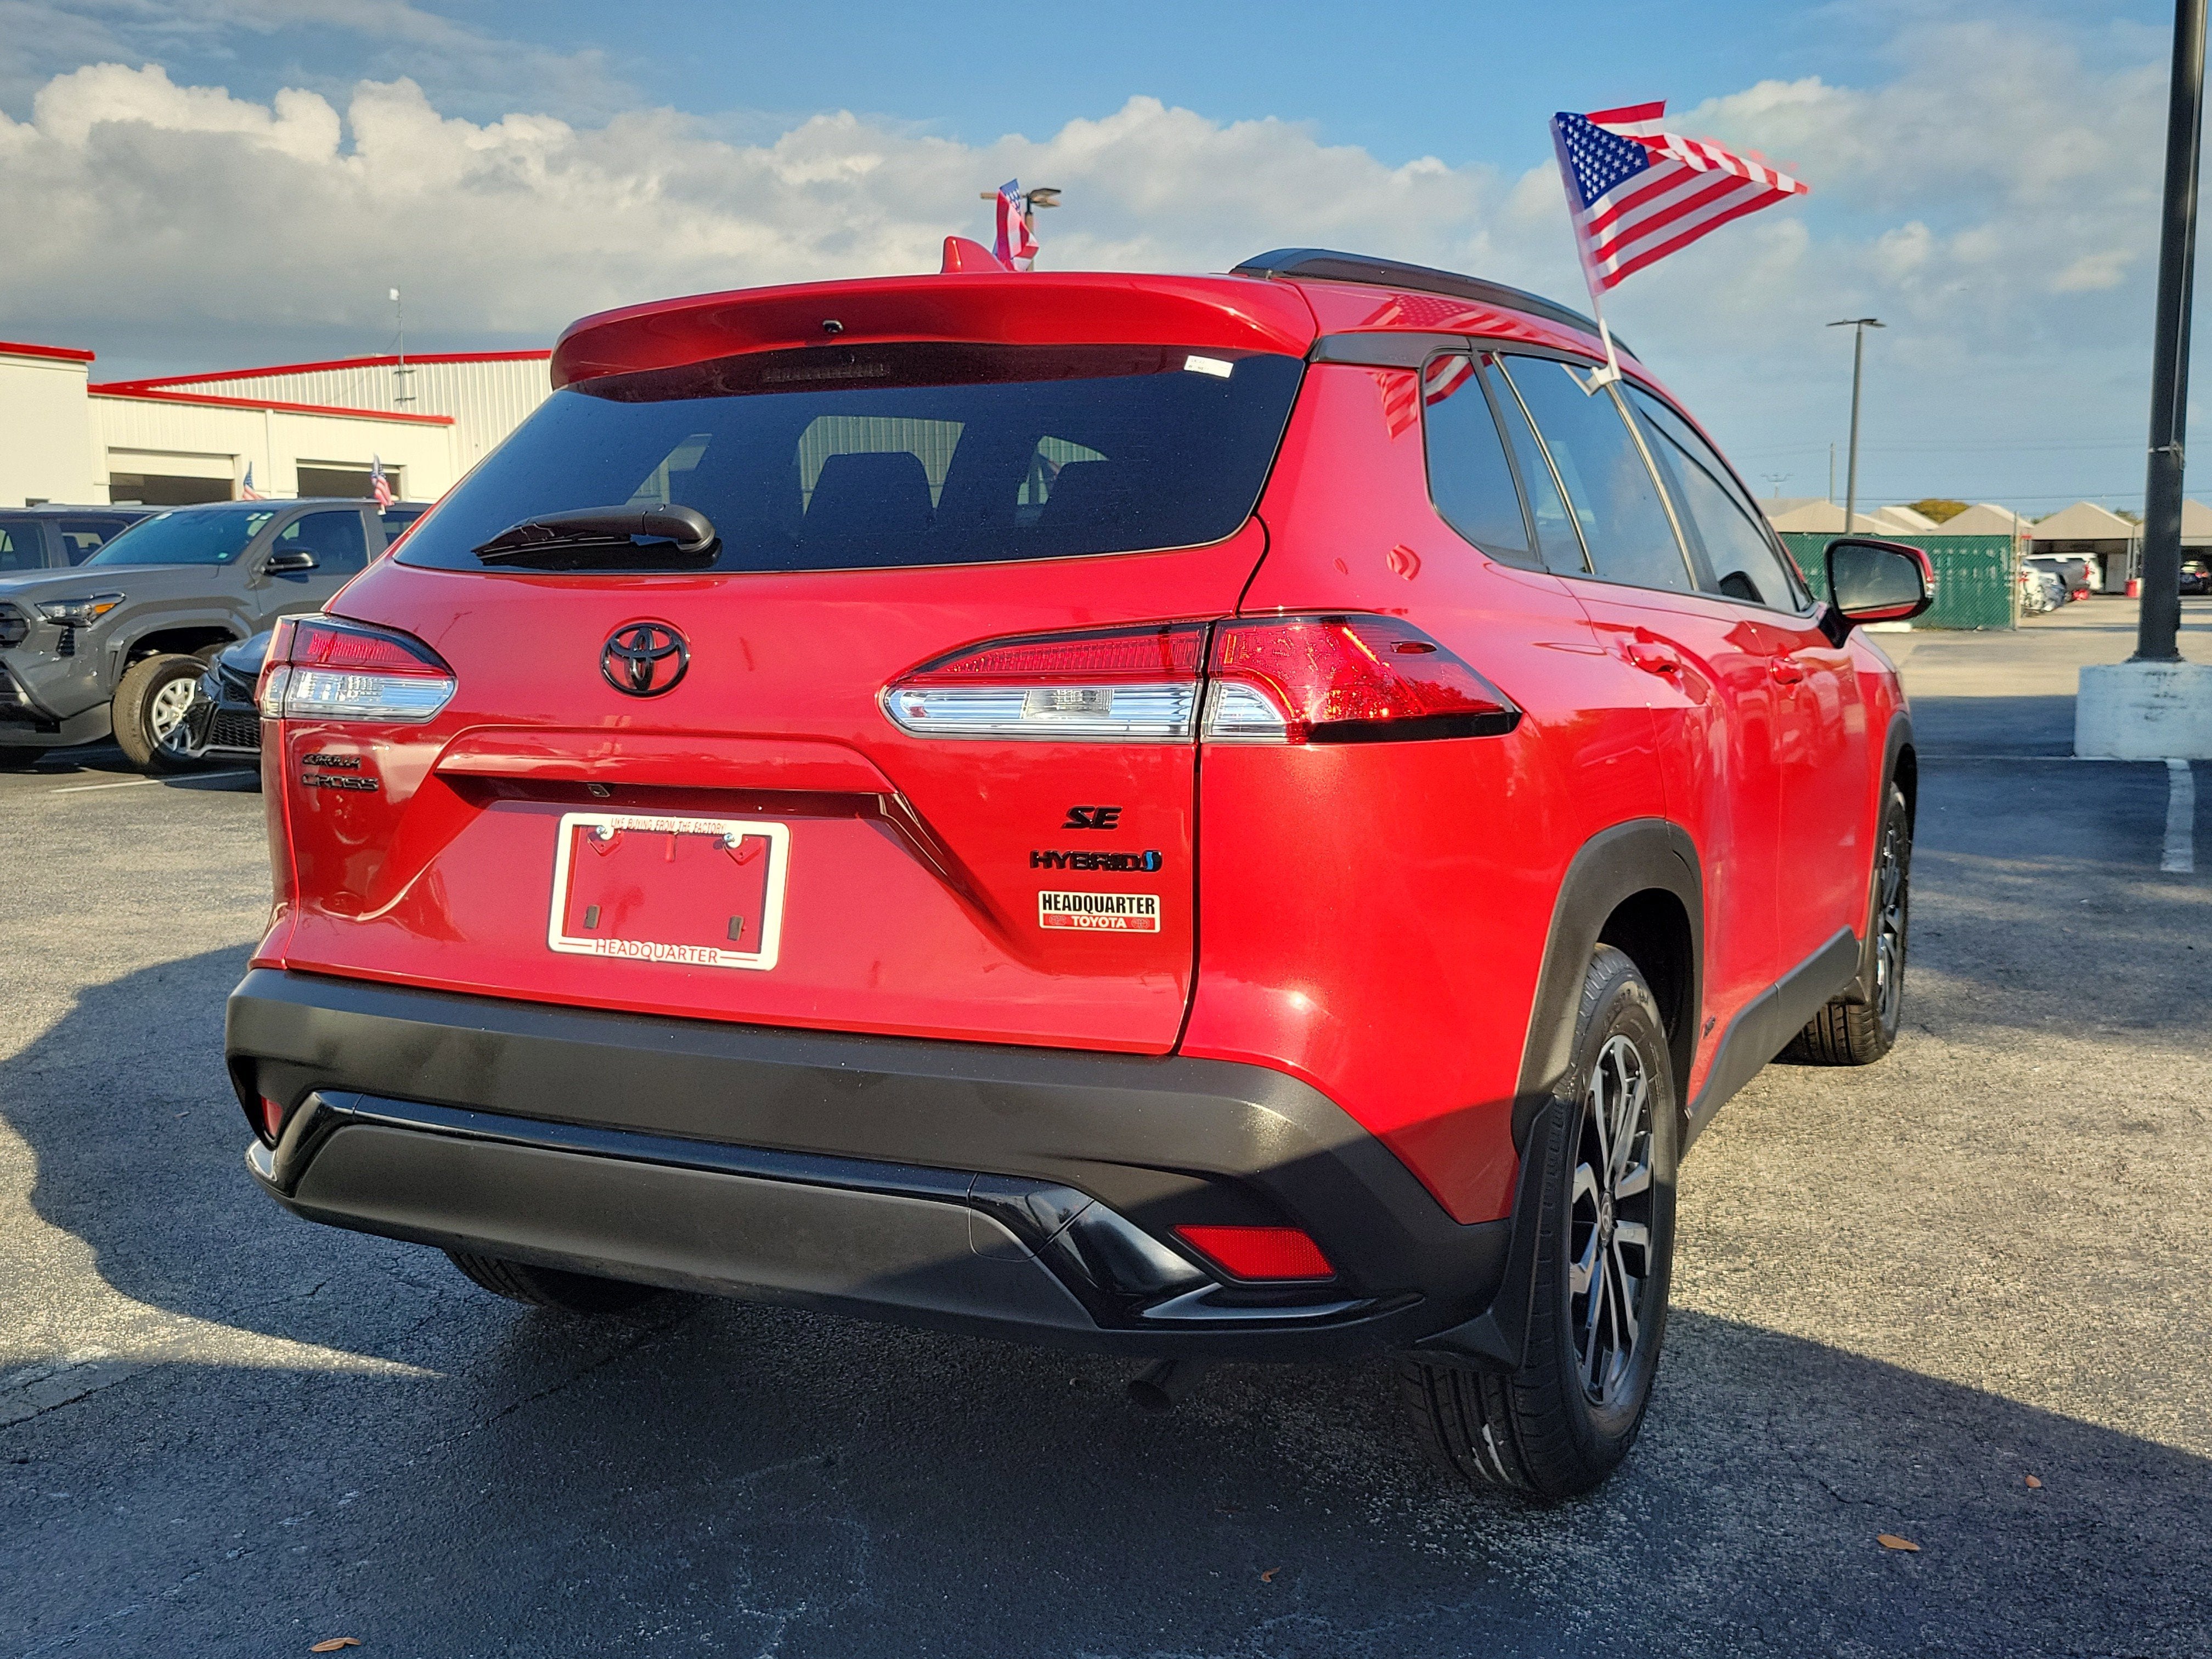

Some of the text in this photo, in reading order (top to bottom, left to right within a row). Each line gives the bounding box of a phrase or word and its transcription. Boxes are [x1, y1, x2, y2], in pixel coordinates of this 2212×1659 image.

[302, 773, 379, 791] CROSS
[611, 817, 625, 827] LIKE
[628, 818, 652, 830] BUYING
[656, 819, 675, 831] FROM
[677, 821, 692, 832] THE
[1062, 806, 1122, 830] SE
[1030, 850, 1142, 871] HYBRID
[1042, 894, 1155, 915] HEADQUARTER
[1071, 916, 1126, 929] TOYOTA
[595, 939, 718, 963] HEADQUARTER
